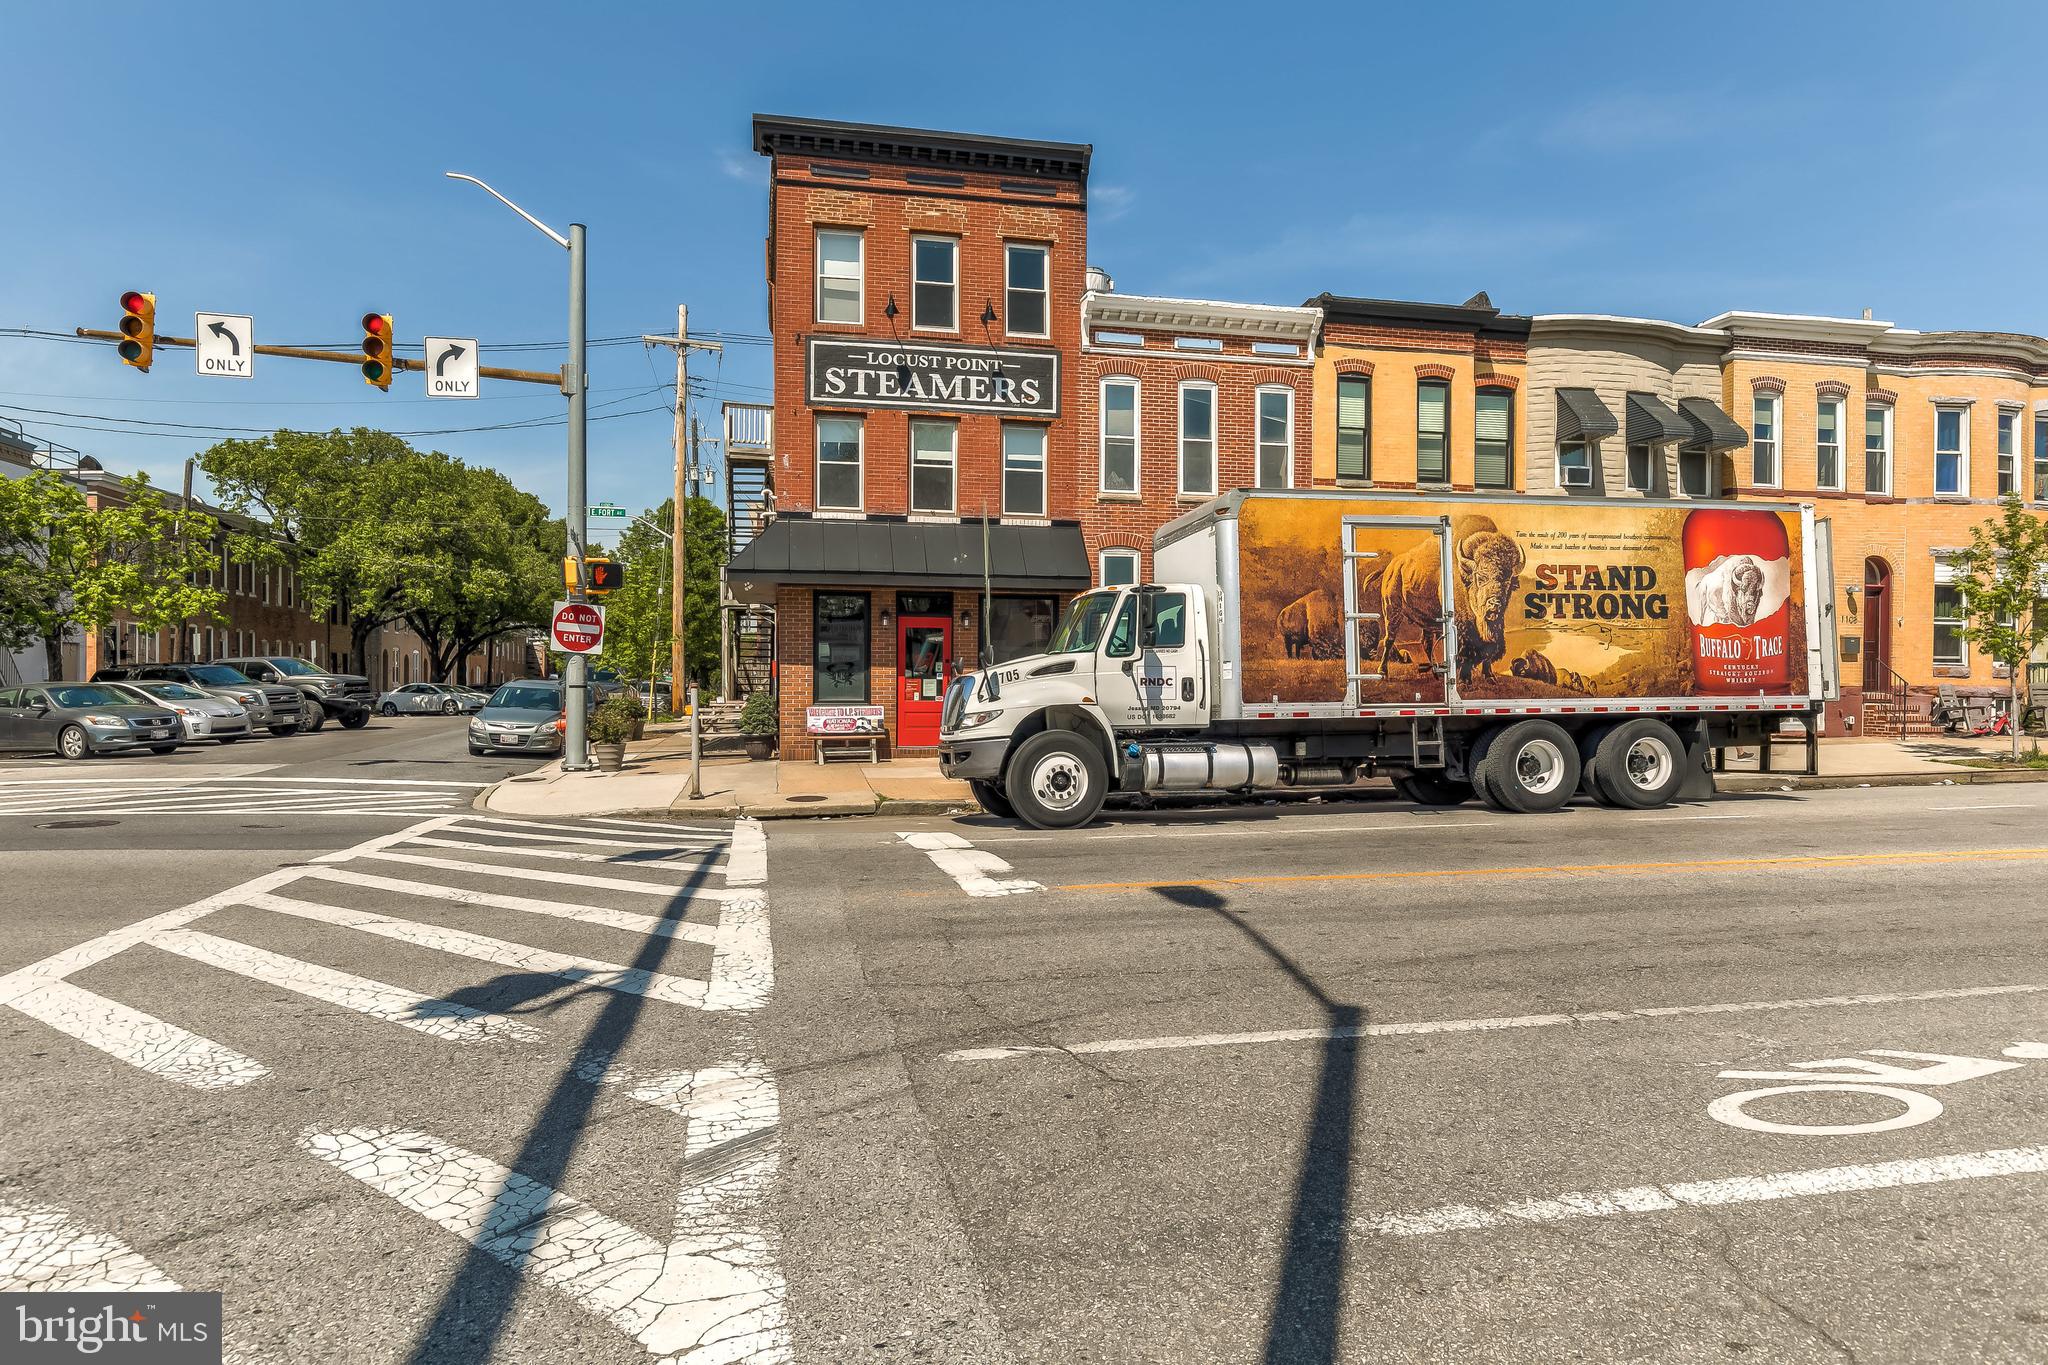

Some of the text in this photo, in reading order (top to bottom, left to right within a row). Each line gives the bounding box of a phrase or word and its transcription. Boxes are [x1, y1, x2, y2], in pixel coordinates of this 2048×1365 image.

[205, 358, 245, 372] ONLY
[866, 351, 1003, 372] LOCUST POINT
[435, 380, 470, 392] ONLY
[825, 367, 1041, 405] STEAMERS
[598, 509, 615, 517] FORT
[1550, 532, 1556, 540] of
[1581, 532, 1587, 540] of
[1535, 563, 1657, 591] STAND
[1524, 592, 1669, 620] STRONG
[561, 612, 597, 623] DO NOT
[563, 633, 592, 644] ENTER
[1699, 633, 1783, 660] BUFFALO TRACE
[1709, 669, 1740, 677] STRAIGHT
[1140, 677, 1173, 687] RNDC
[837, 708, 844, 717] TO
